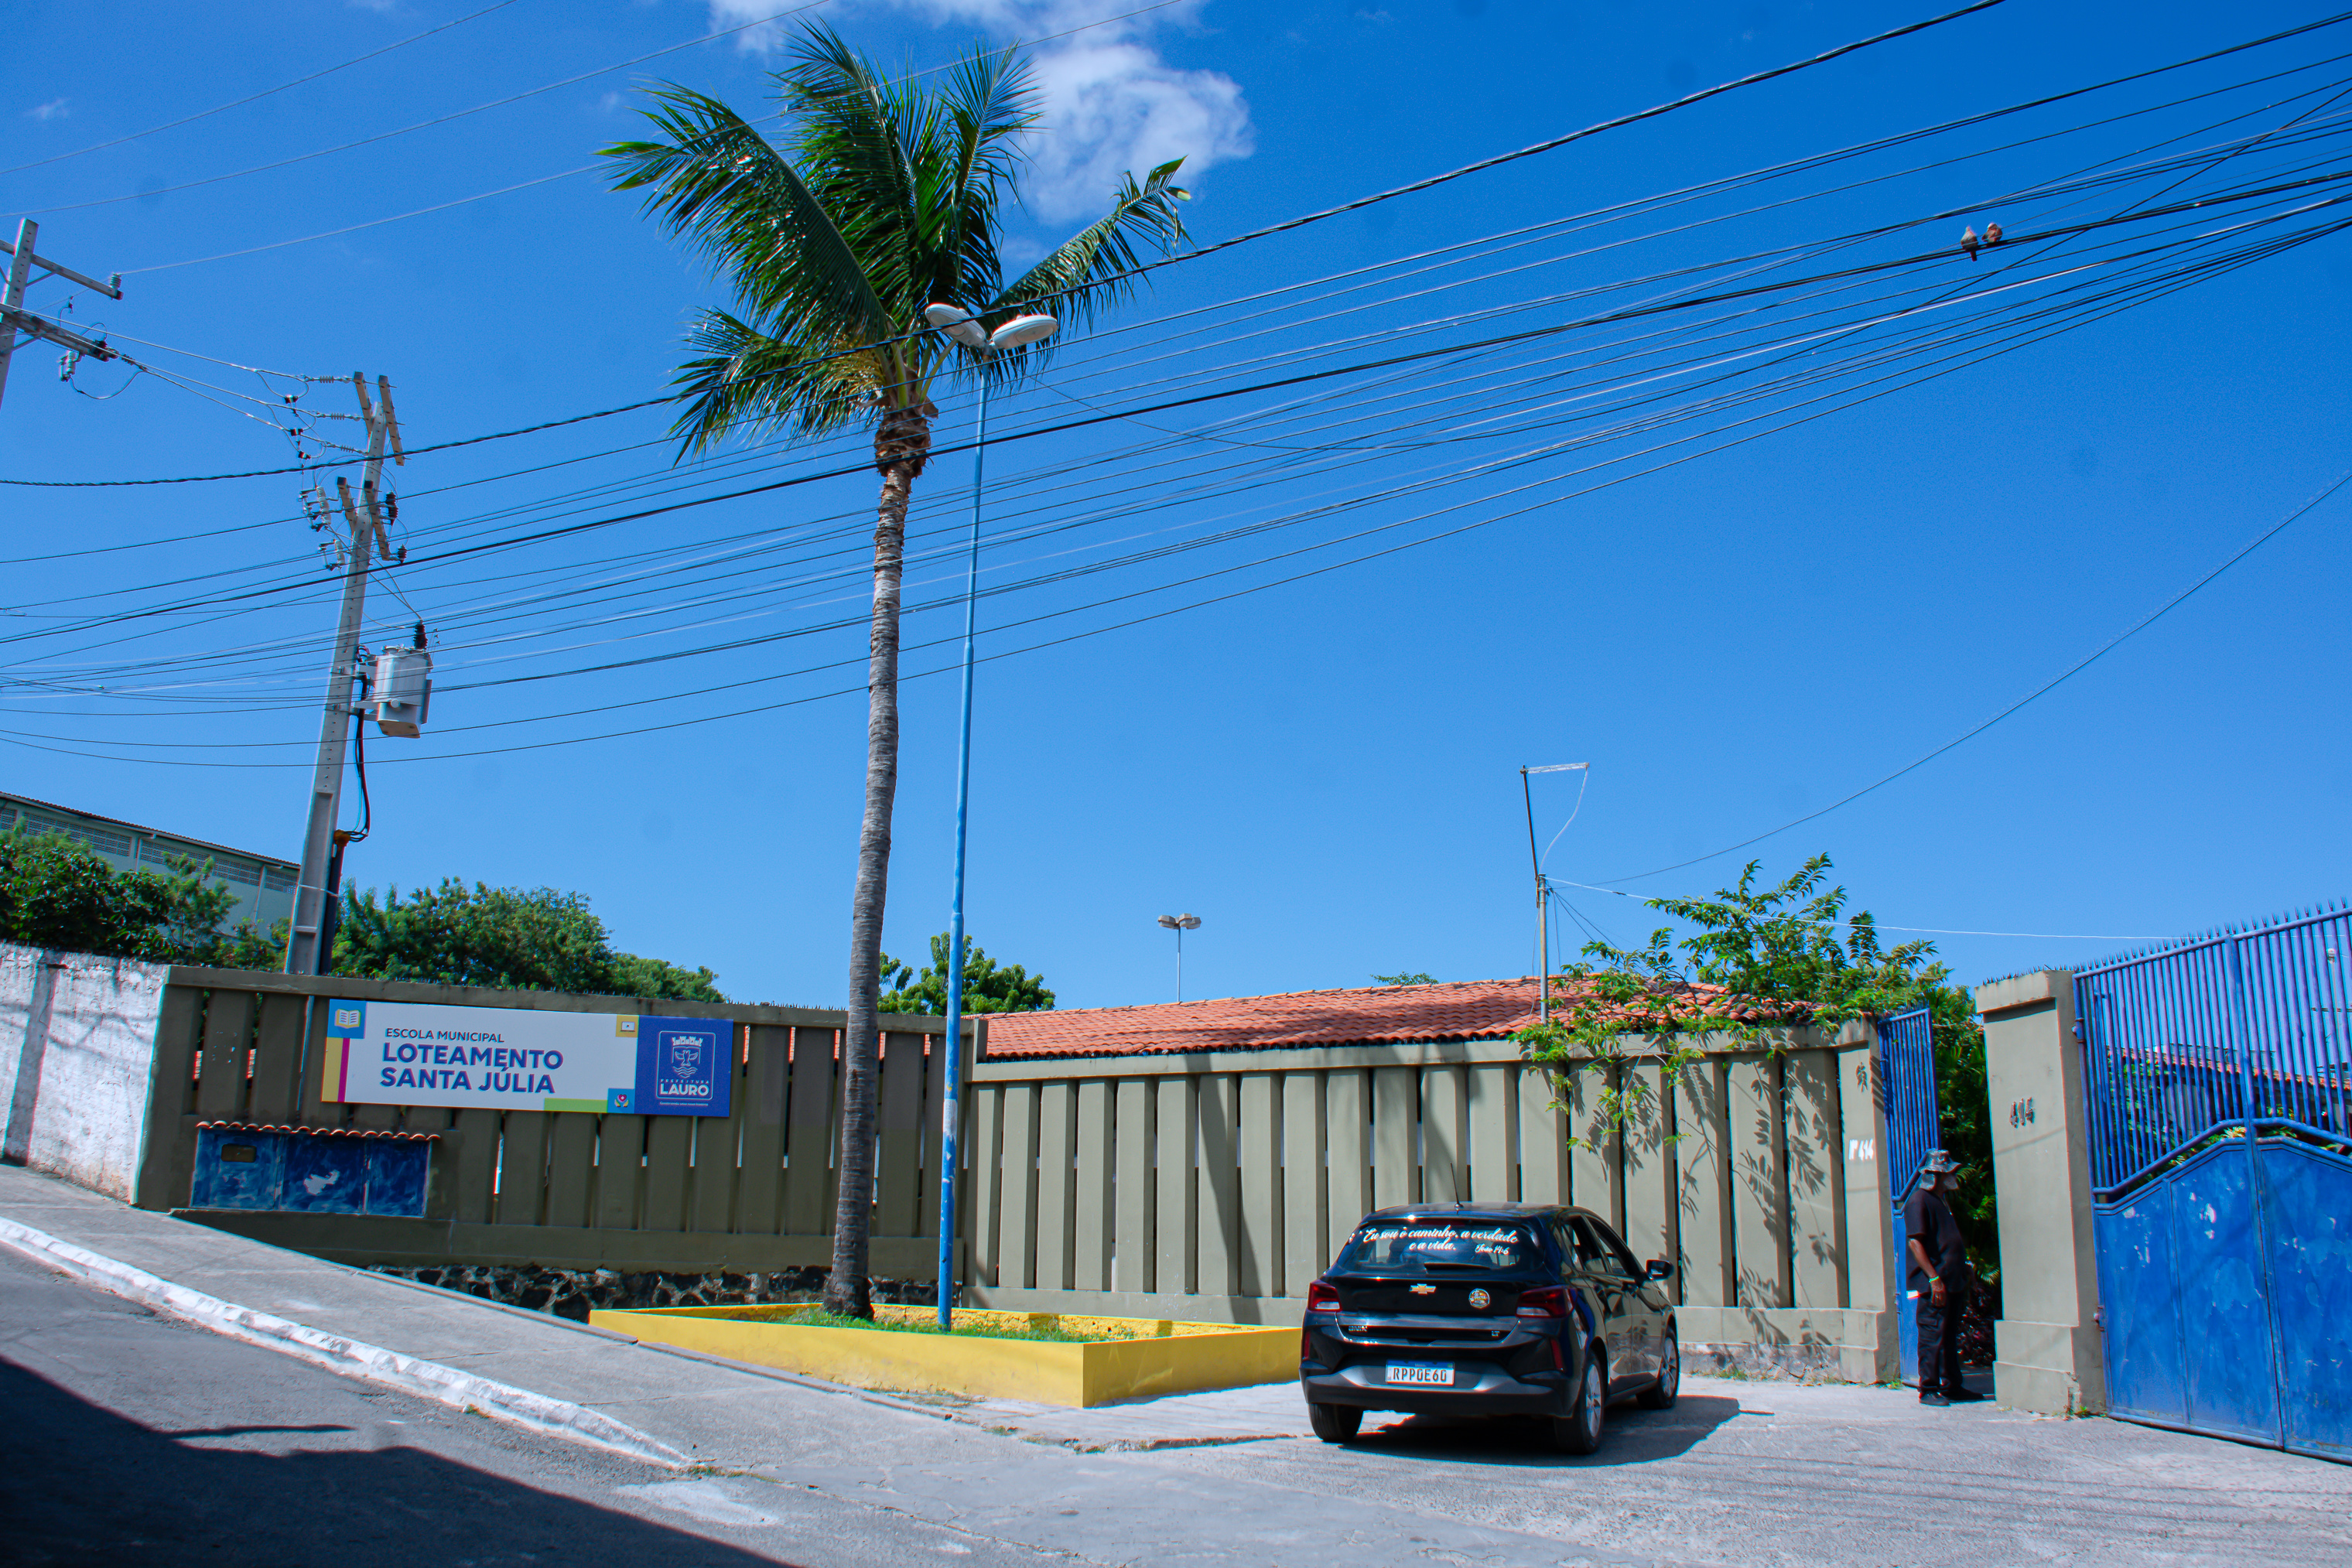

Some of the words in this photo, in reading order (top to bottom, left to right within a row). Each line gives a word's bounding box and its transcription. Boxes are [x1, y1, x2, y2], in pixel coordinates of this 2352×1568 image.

[385, 1027, 434, 1040] ESCOLA
[437, 1030, 504, 1043] MUNICIPAL
[382, 1042, 564, 1070] LOTEAMENTO
[380, 1067, 472, 1091] SANTA
[478, 1067, 556, 1094] JÚLIA
[660, 1083, 709, 1096] LAURO
[1362, 1228, 1379, 1243] Eu
[1379, 1231, 1399, 1239] sou
[1460, 1230, 1470, 1238] a
[1471, 1228, 1518, 1243] verdade
